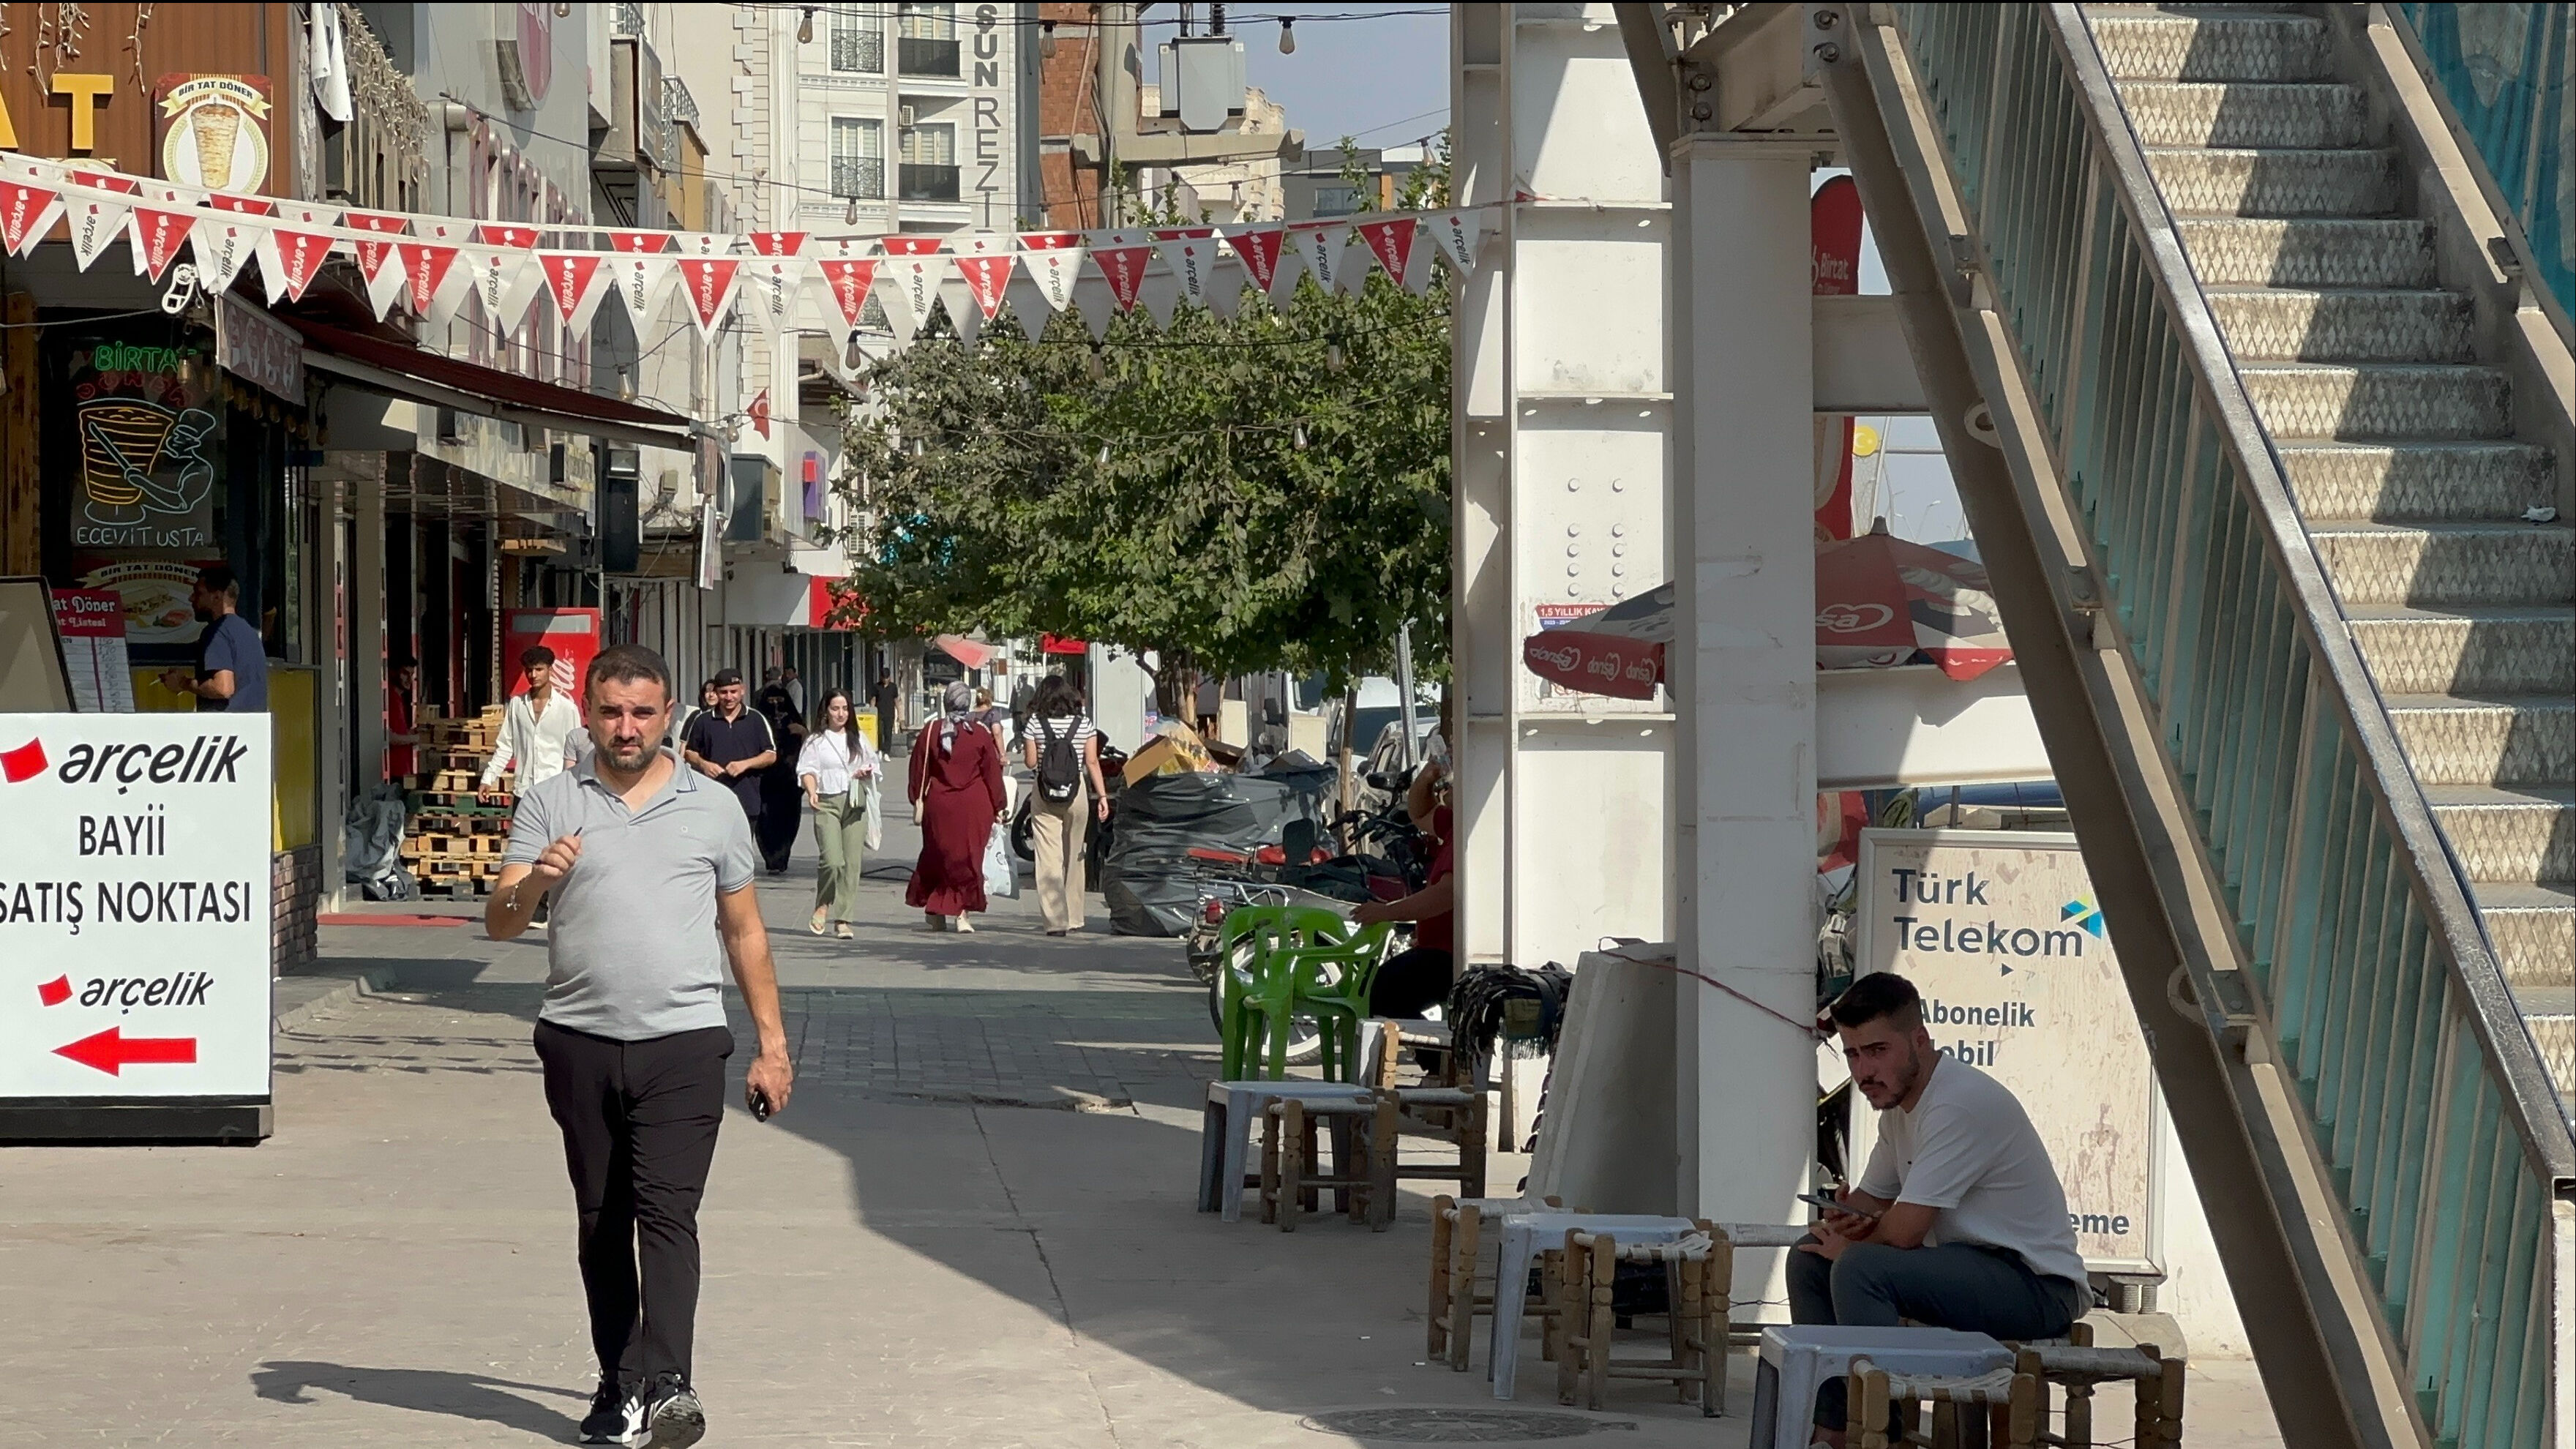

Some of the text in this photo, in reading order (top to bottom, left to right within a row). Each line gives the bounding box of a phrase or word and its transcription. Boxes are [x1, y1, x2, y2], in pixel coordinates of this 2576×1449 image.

[178, 80, 253, 100] BİR TAT DÖNER
[975, 97, 1001, 233] REZİ
[9, 201, 26, 242] arçelik
[80, 215, 96, 257] arçelik
[151, 227, 168, 267] arçelik
[221, 239, 235, 278] arçelik
[366, 242, 378, 272] rçelik
[1253, 243, 1270, 281] arçelik
[1317, 244, 1330, 283] arçelik
[1384, 237, 1403, 274] arçelik
[1452, 228, 1469, 265] arçelik
[418, 261, 430, 302] arçelik
[487, 269, 499, 307] arçelik
[563, 270, 575, 311] arçelik
[634, 272, 645, 311] arçelik
[702, 274, 714, 315] arçelik
[772, 276, 783, 316] arçelik
[844, 274, 855, 314] arçelik
[913, 275, 926, 315] arçelik
[1048, 269, 1064, 304] arçelik
[1116, 263, 1131, 303] arçelik
[1185, 258, 1201, 296] arçelik
[157, 527, 203, 547] USTA
[52, 596, 116, 613] at Döner
[1530, 646, 1572, 667] donsa
[1587, 656, 1614, 676] donsa
[1626, 661, 1650, 681] donsa
[58, 735, 248, 795] arçelik
[79, 803, 165, 856] BAYİİ
[97, 880, 251, 924] NOKTASI
[1892, 868, 1990, 906] Türk
[1893, 916, 2083, 957] Telekom
[79, 971, 214, 1015] arçelik
[1919, 997, 2036, 1027] Abonelik
[1930, 1038, 1994, 1067] obil
[2068, 1213, 2130, 1235] eme
